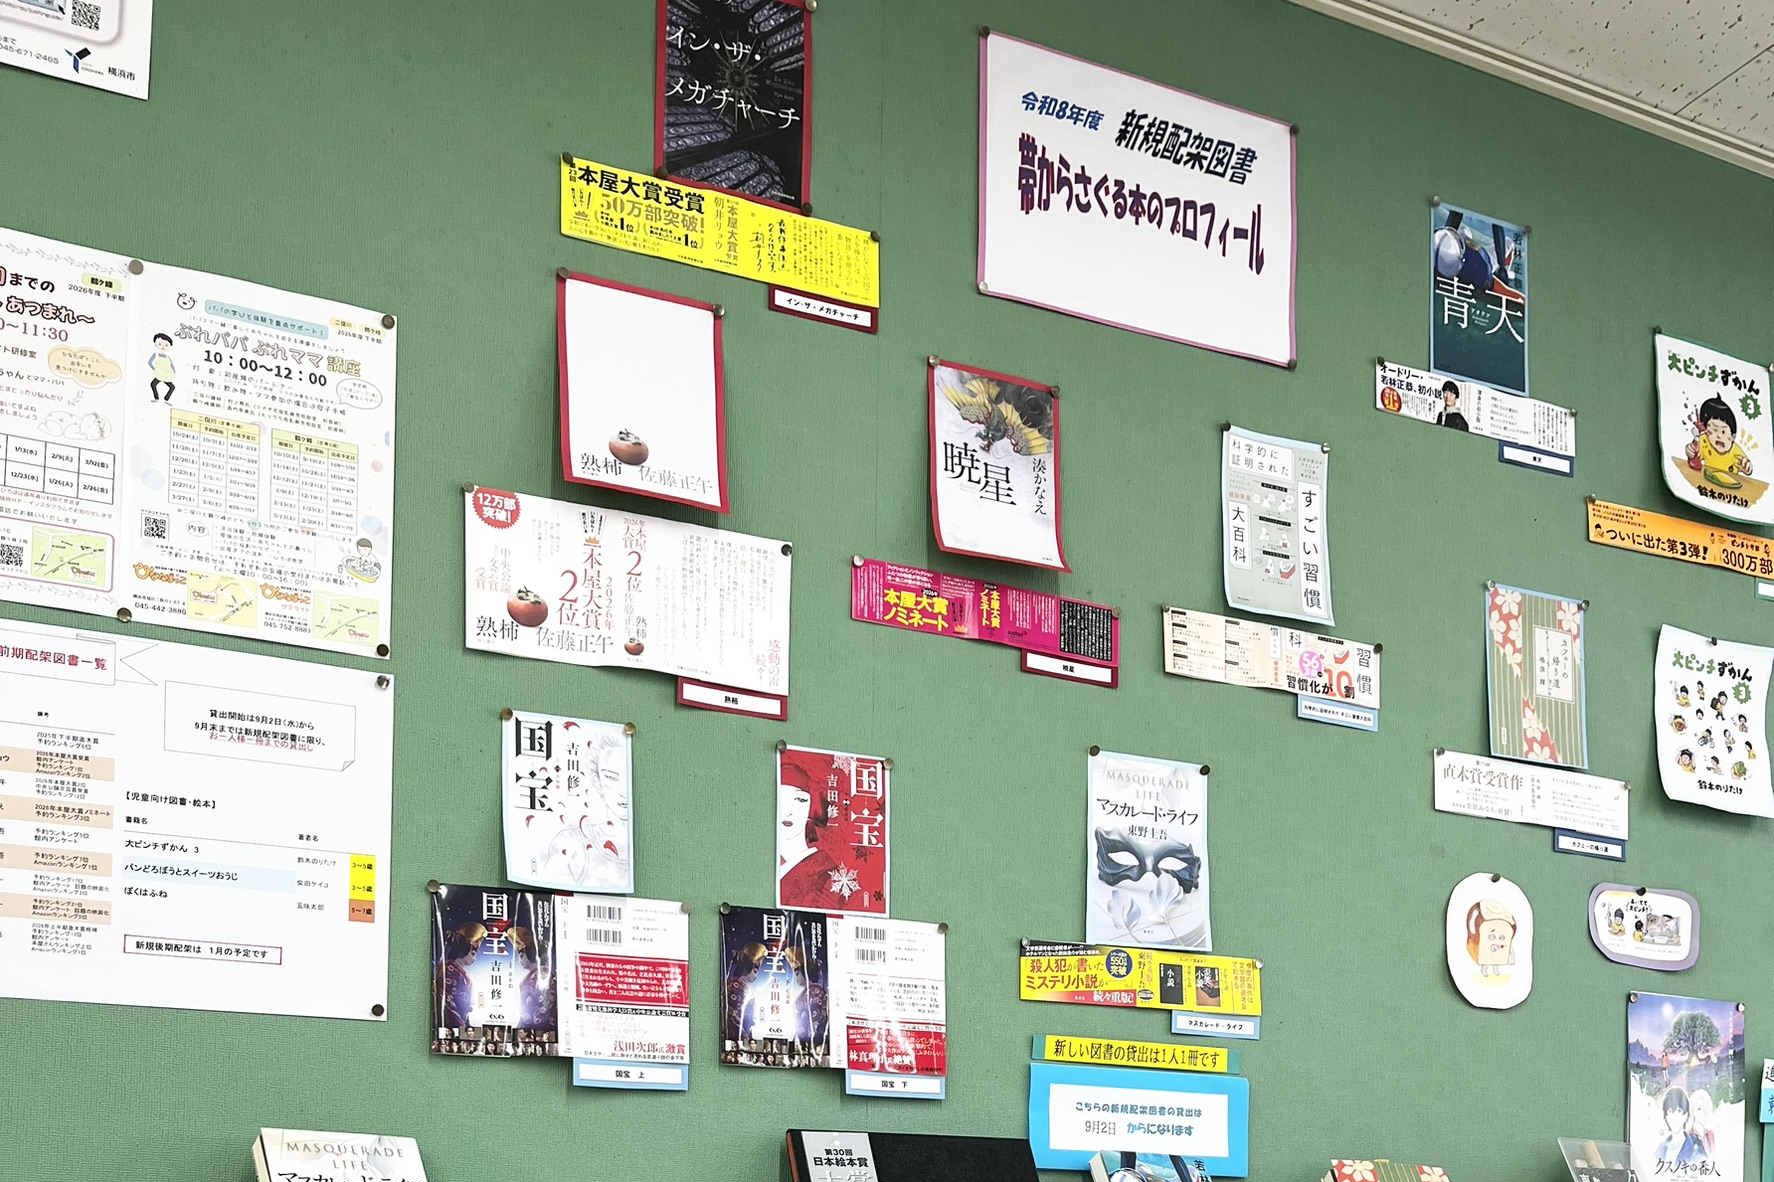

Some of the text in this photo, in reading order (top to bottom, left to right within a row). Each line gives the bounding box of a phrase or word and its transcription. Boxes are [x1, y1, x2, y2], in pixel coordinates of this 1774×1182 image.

[665, 76, 801, 130] メガチャーチ
[1021, 90, 1257, 185] 令和8年度 新規配架図書
[578, 165, 705, 214] 本屋大賞受賞
[1017, 132, 1265, 275] 帯からさぐる本のプロフィール
[600, 193, 705, 234] 50万部突破!
[727, 205, 739, 254] 本屋大賞
[1435, 275, 1525, 343] 青天
[326, 355, 361, 377] 講座
[1667, 353, 1760, 414] 大ピンチずかん 3
[1232, 438, 1279, 460] 科学的に
[580, 452, 622, 476] 熟柿
[943, 441, 1017, 506] 暁星
[1231, 454, 1290, 476] 証明された
[1032, 457, 1047, 516] 湊かなえ
[1232, 506, 1246, 563] 大百科
[1606, 528, 1709, 561] ついに出た第3弾!
[1301, 489, 1322, 610] すごい習慣
[627, 551, 642, 593] 2位
[557, 570, 580, 627] 2位
[583, 549, 602, 630] 本屋大賞
[884, 588, 949, 615] 本屋大賞
[883, 606, 949, 632] ノミネート
[476, 615, 614, 654] 熟柿 佐藤正午
[1672, 651, 1753, 699] 大ピンチずかん 3
[514, 716, 553, 812] 国宝
[566, 743, 580, 798] 吉田修一
[1444, 764, 1524, 791] 直木賞受賞作
[1107, 770, 1190, 791] MASQUERADE
[826, 773, 839, 828] 吉田修一
[850, 759, 885, 848] 国宝
[1096, 798, 1199, 826] マスカレード・ライフ
[125, 840, 188, 854] 大ピンチずかん
[1128, 825, 1168, 841] 東野圭吾
[124, 863, 239, 882] パンどろぼうとスイーツおうじ
[124, 887, 168, 899] ぼくはふね
[135, 940, 201, 955] 新規後期配架は
[1053, 1039, 1220, 1067] 新しい図書の貸出は1人1冊です
[615, 1070, 646, 1079] 国宝 上
[881, 1080, 908, 1089] 国宝 下
[1075, 1102, 1202, 1118] こちらの新規配架図書の貸出は
[1085, 1120, 1194, 1136] 9月2日 からになります
[286, 1141, 405, 1158] MASQUERADE
[813, 1156, 869, 1168] 日本絵本賞
[825, 1148, 853, 1157] 第30回
[333, 1159, 368, 1171] LIFE
[1654, 1157, 1721, 1177] クスノキの番人
